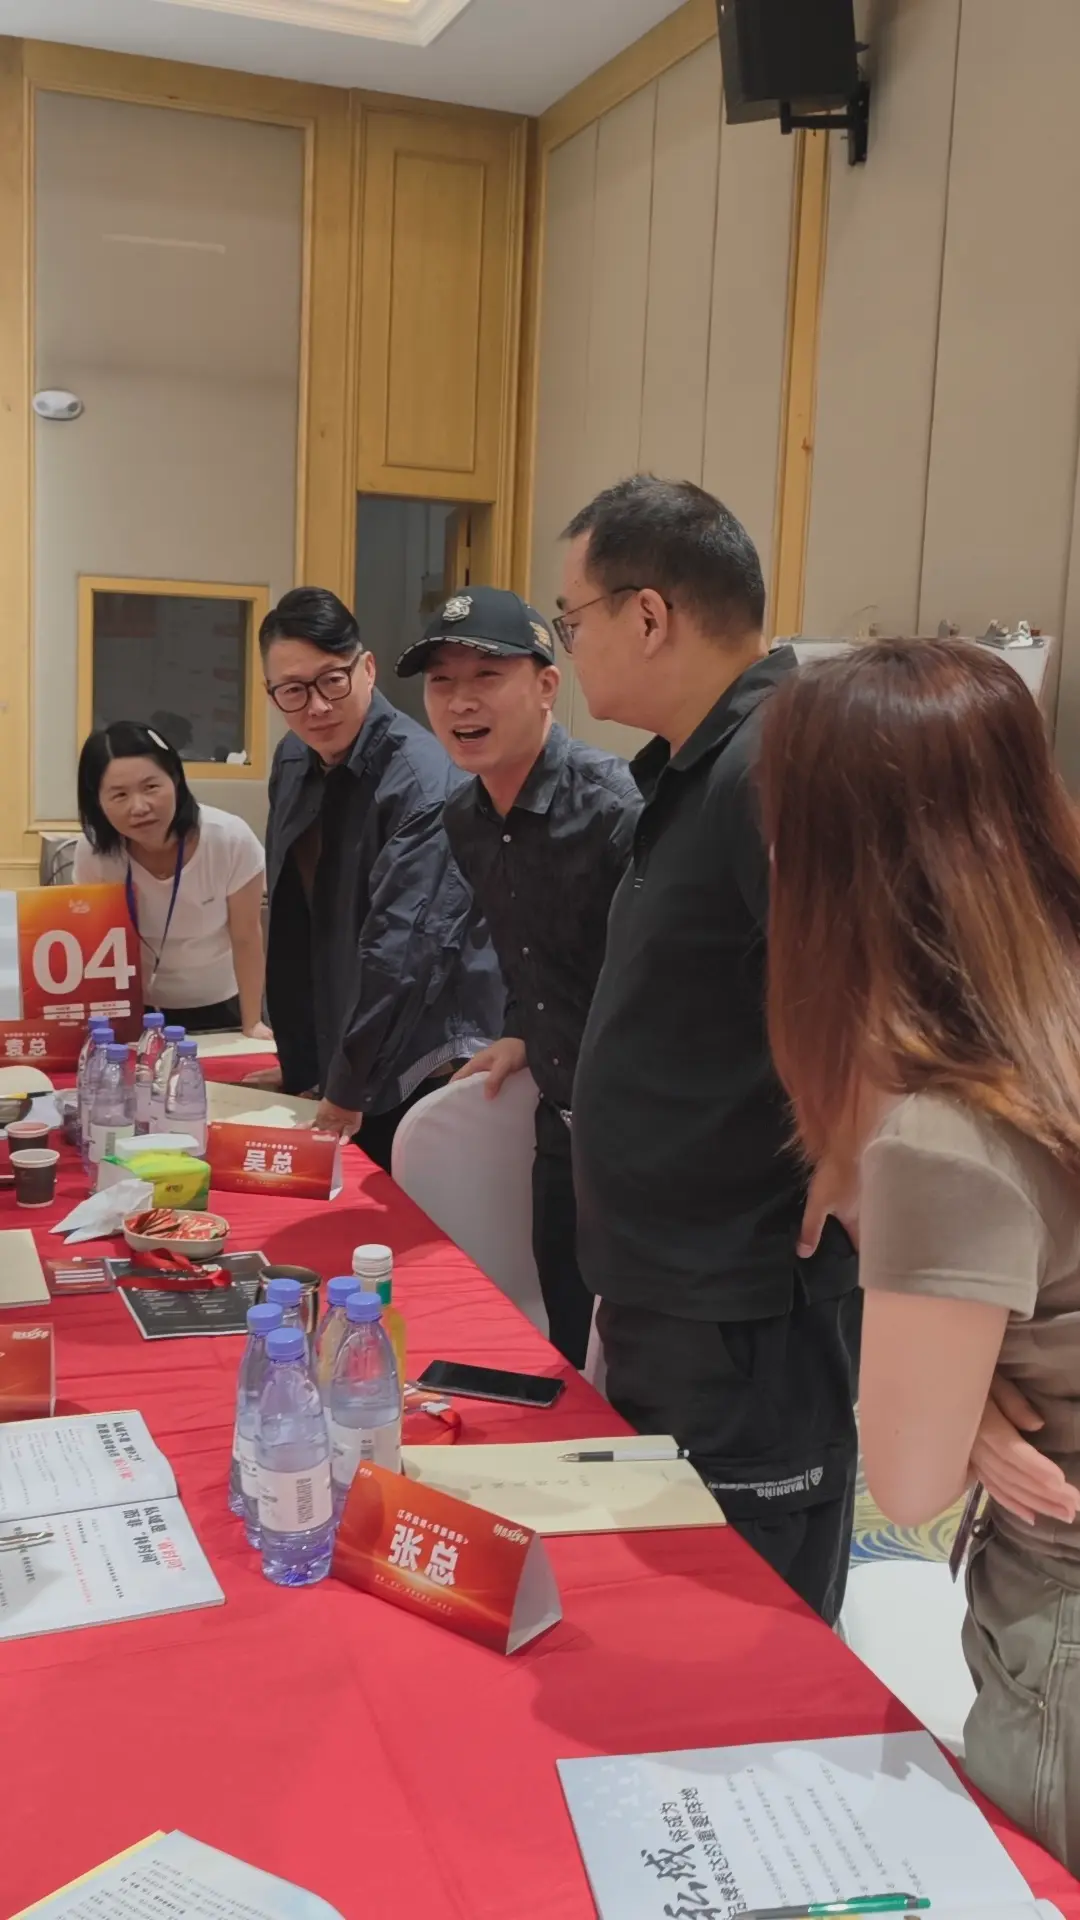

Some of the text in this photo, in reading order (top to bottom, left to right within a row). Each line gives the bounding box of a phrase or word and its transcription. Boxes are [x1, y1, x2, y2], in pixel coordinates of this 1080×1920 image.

[32, 927, 136, 994] 04
[5, 1038, 47, 1057] 袁总
[243, 1149, 293, 1174] 吴总
[757, 1480, 805, 1499] WARNING
[388, 1524, 459, 1586] 张总
